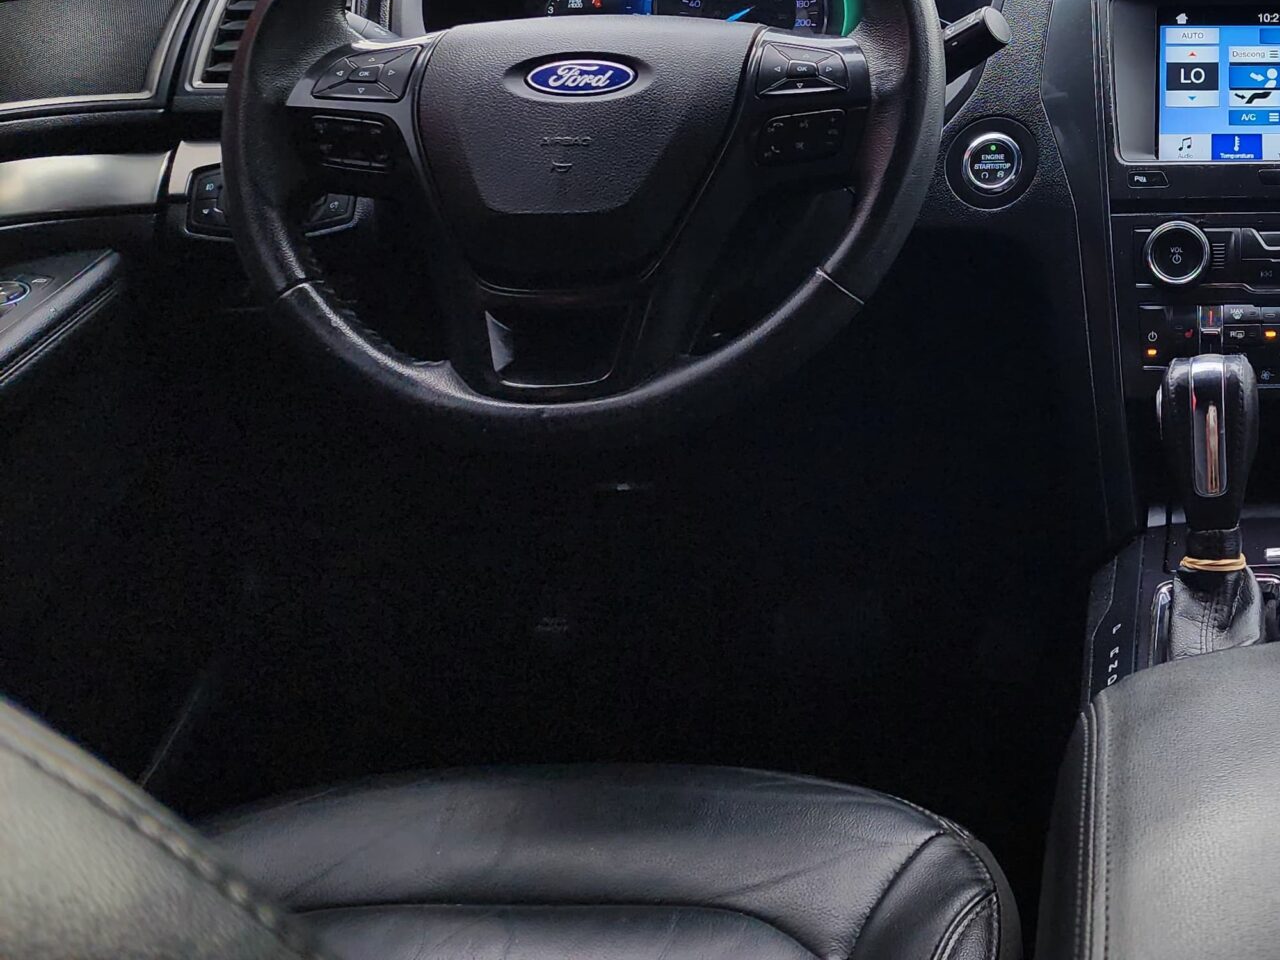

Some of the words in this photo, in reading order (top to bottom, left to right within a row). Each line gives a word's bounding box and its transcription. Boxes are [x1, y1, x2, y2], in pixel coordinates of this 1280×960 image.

[796, 0, 810, 8] 180
[795, 19, 811, 27] 200
[548, 64, 614, 87] Ford
[1180, 68, 1205, 83] LO
